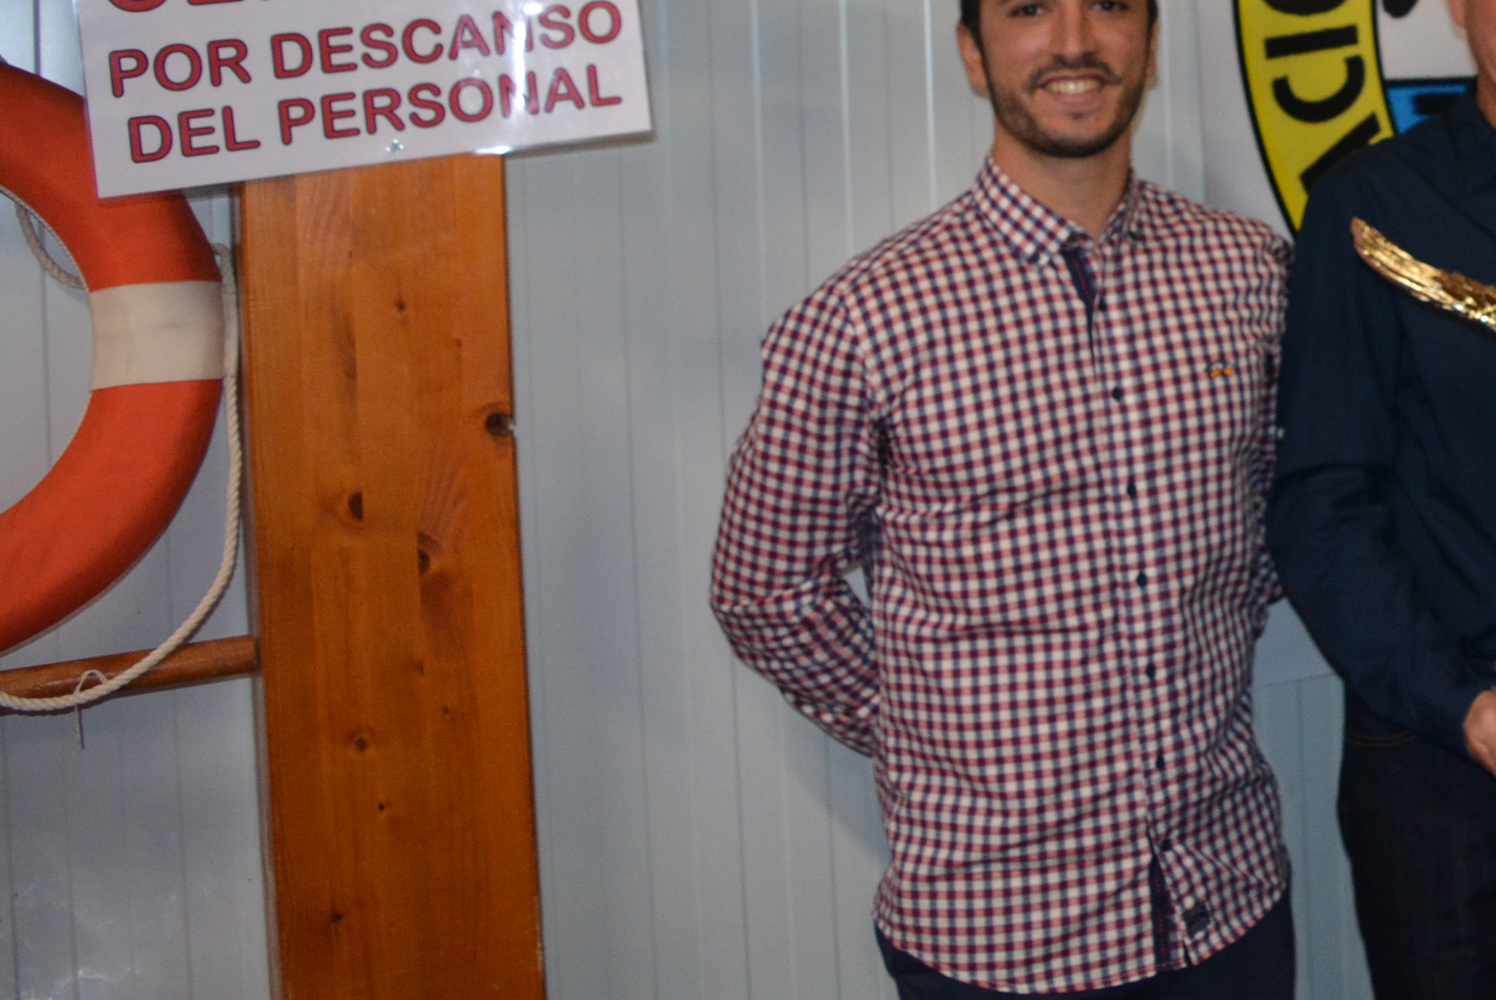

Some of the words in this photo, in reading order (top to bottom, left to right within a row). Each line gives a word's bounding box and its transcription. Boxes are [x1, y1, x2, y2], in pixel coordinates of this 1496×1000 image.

[108, 38, 252, 98] POR
[270, 0, 623, 80] DESCANSO
[127, 105, 261, 164] DEL
[277, 63, 623, 145] PERSONAL
